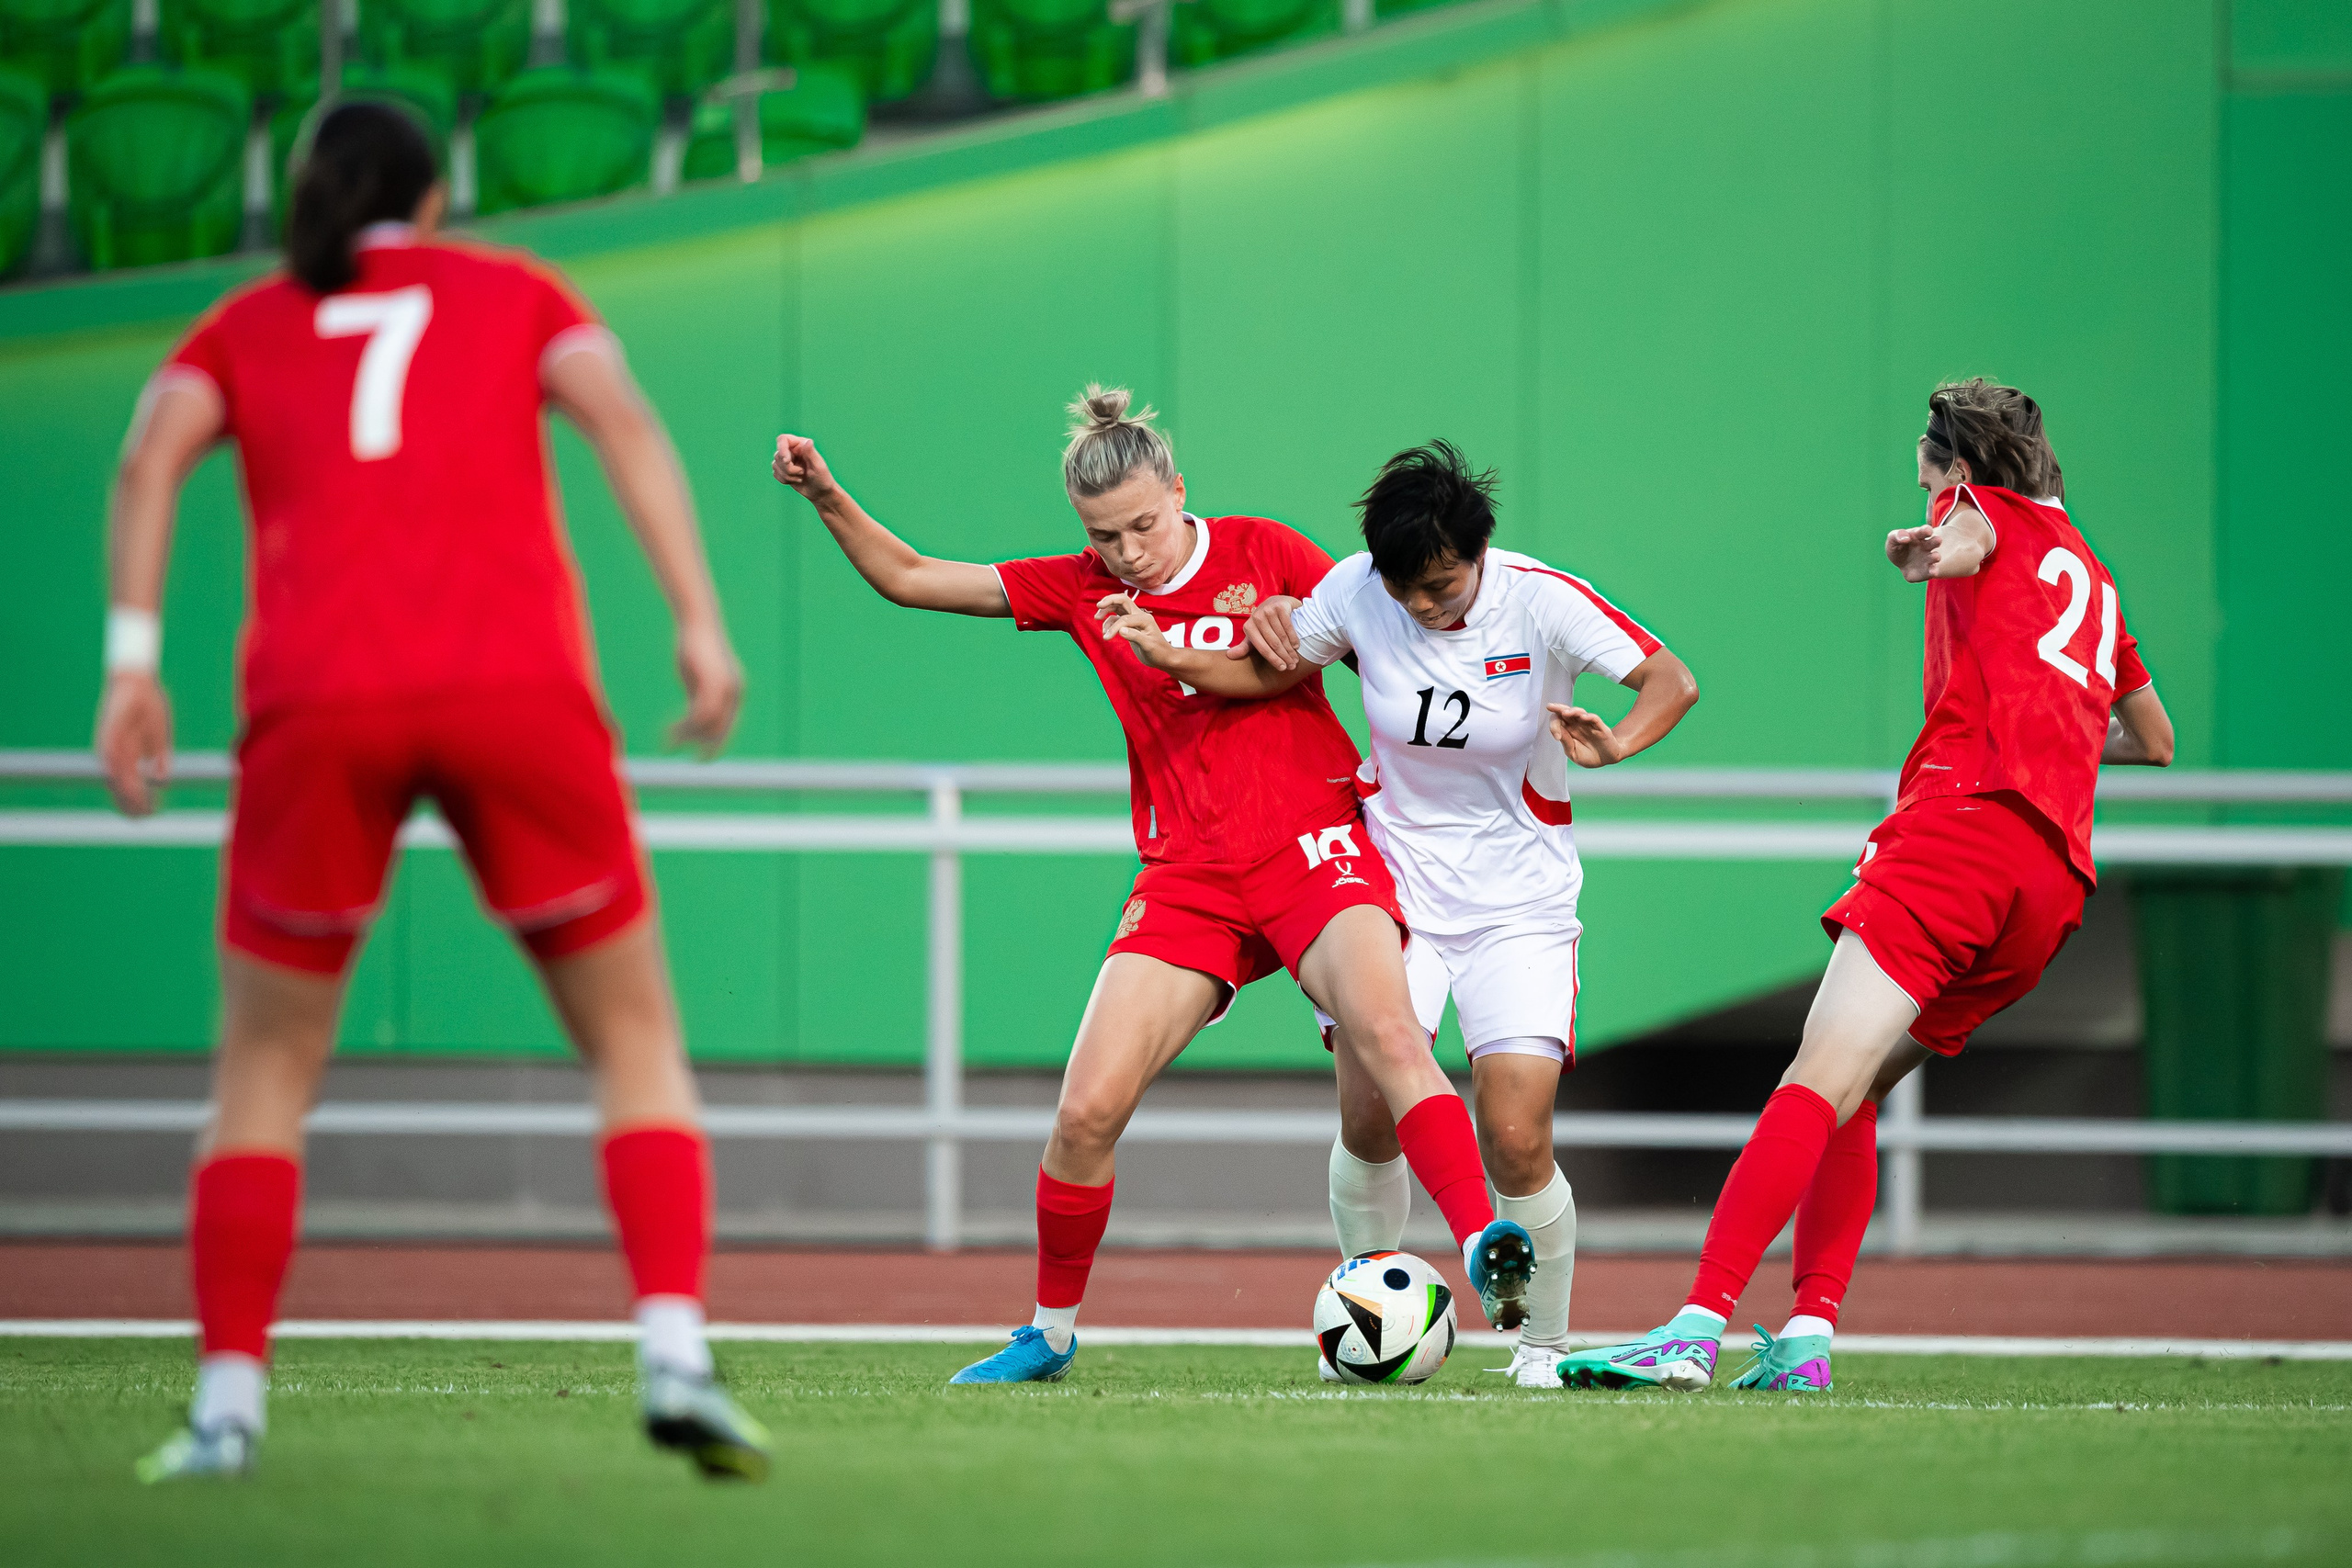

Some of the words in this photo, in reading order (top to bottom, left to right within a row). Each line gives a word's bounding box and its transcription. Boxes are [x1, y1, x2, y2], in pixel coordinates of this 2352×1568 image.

[313, 284, 435, 462] 7
[2037, 547, 2117, 691] 21
[1408, 686, 1471, 750] 12
